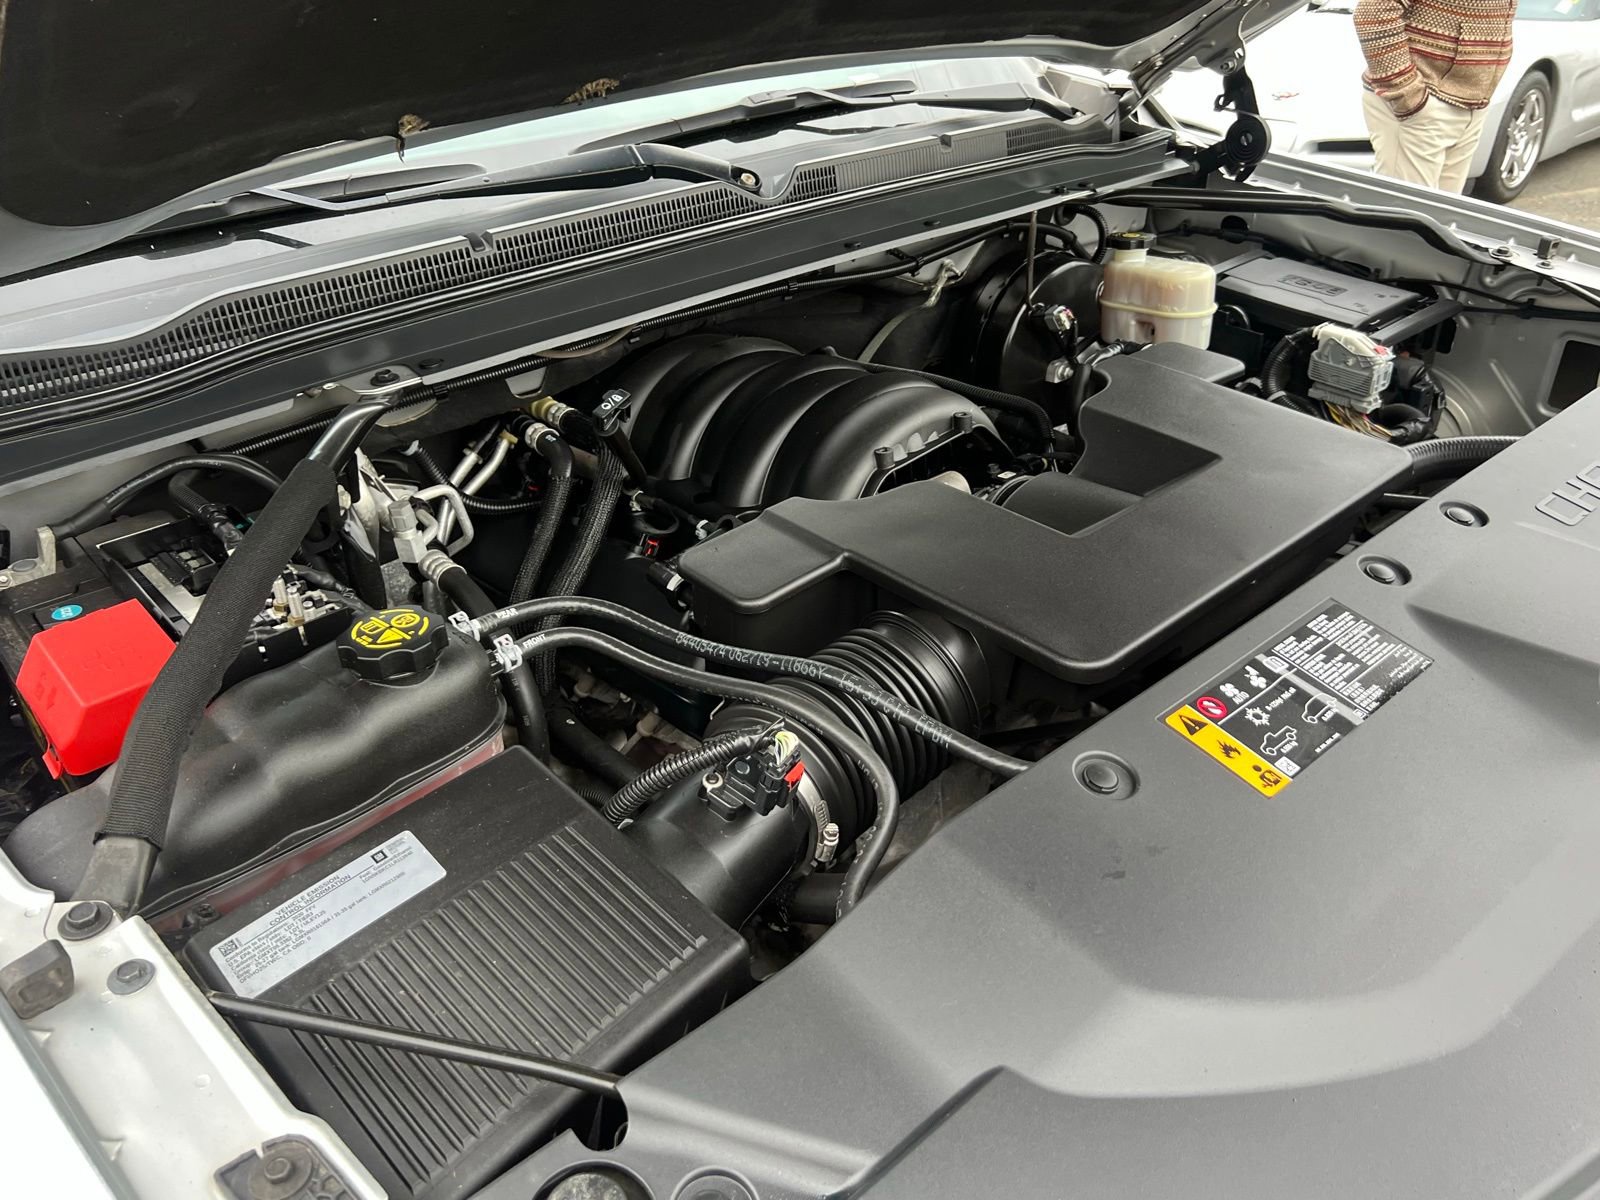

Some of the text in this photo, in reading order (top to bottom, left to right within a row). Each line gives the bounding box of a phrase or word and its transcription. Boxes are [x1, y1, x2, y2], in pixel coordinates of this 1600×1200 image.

[523, 634, 546, 648] FRONT
[1231, 690, 1250, 704] AUTO
[268, 872, 351, 926] CONTROL INFORMATION
[274, 874, 340, 916] VEHICLE EMISSION
[238, 949, 251, 959] EPA
